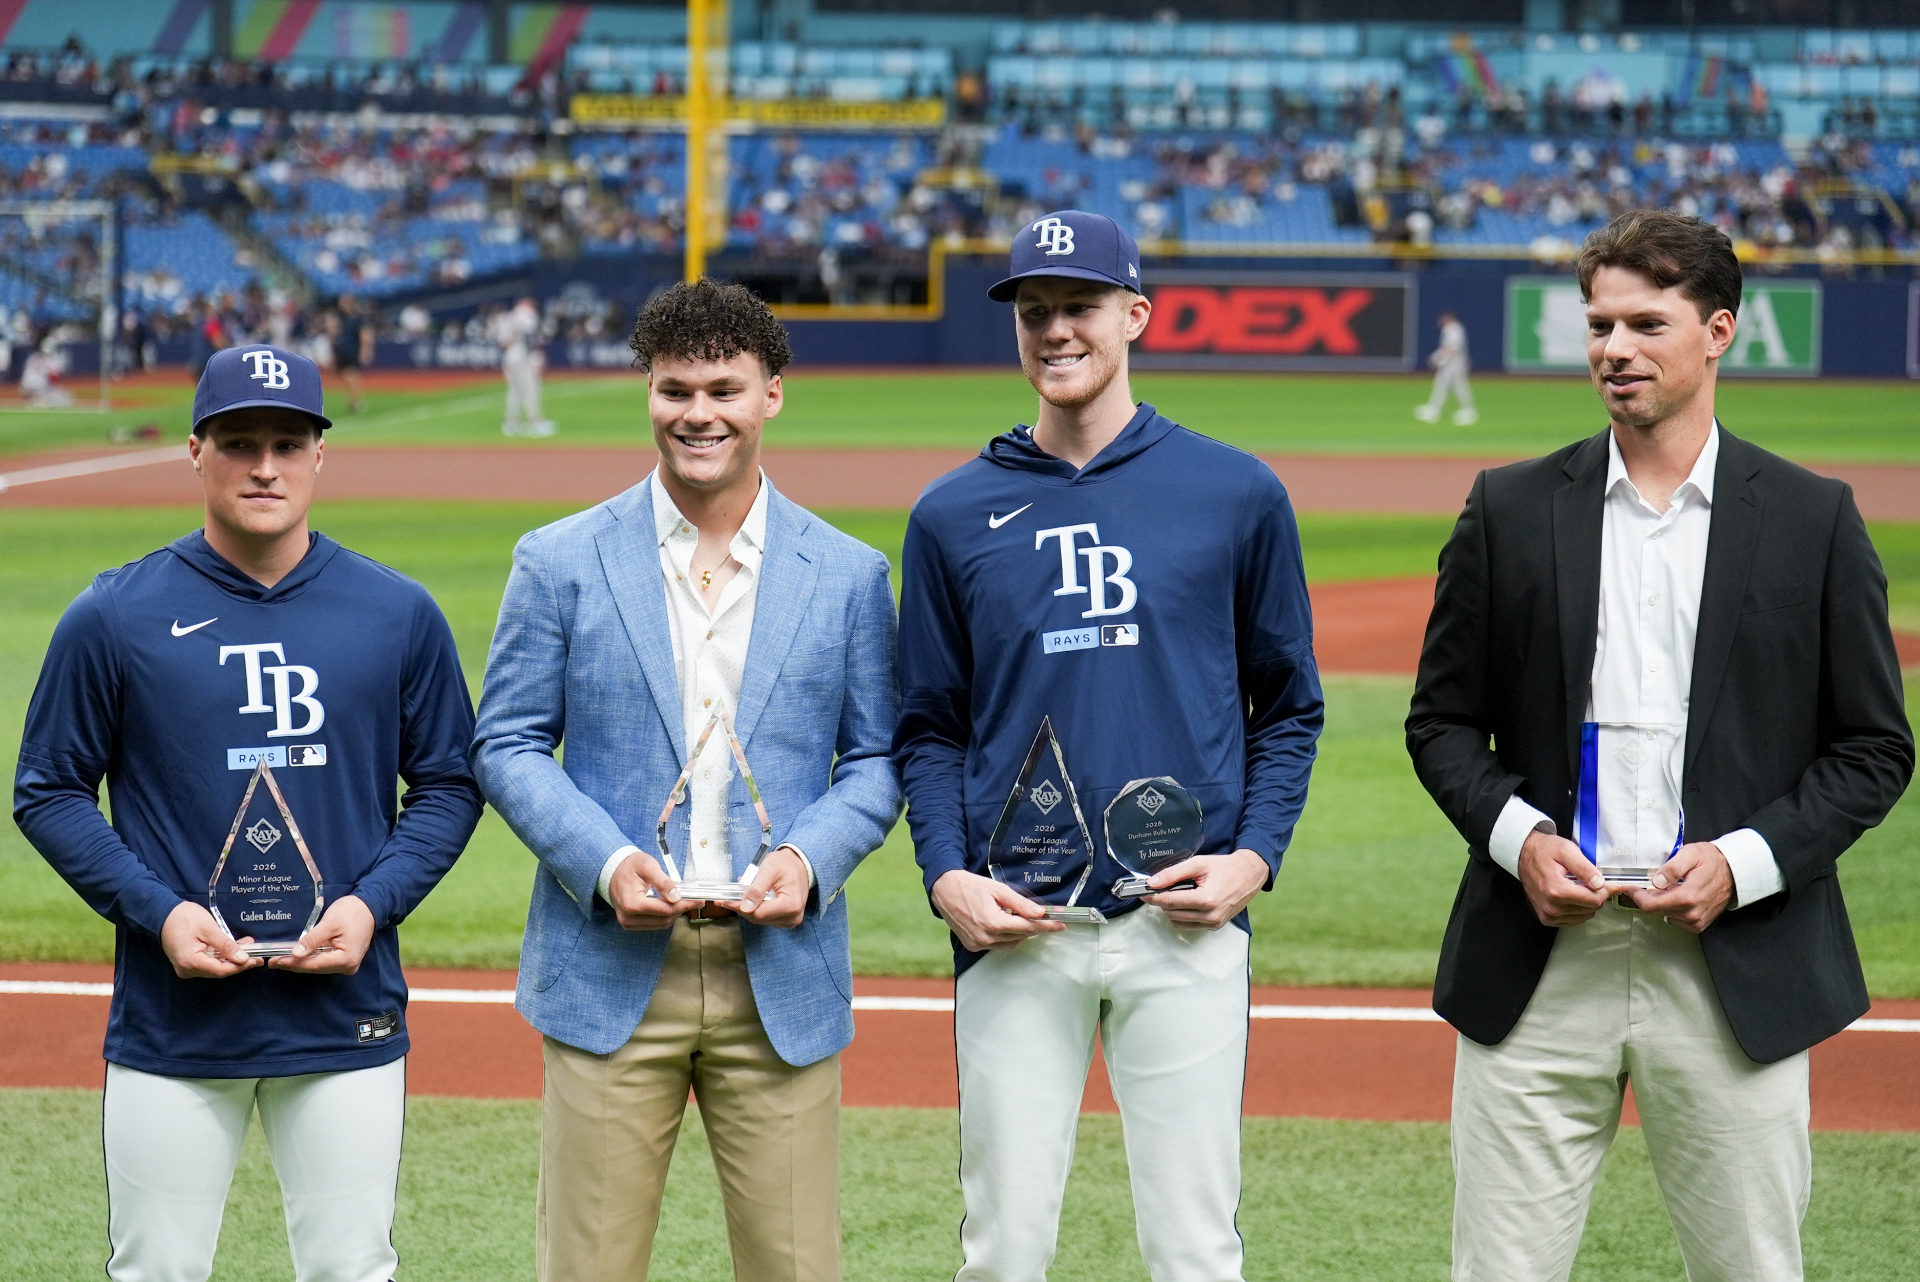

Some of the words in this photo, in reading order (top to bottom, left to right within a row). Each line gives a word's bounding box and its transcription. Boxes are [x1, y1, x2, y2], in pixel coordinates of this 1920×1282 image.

[1031, 217, 1075, 256] TB
[1142, 285, 1373, 355] DEX
[241, 350, 291, 390] TB
[1035, 522, 1139, 619] TB
[1053, 633, 1091, 647] RAYS
[218, 642, 326, 738] TB
[1034, 824, 1056, 832] 2026
[1145, 820, 1163, 828] 2026
[1020, 836, 1041, 844] Minor
[1042, 836, 1069, 846] League
[1128, 832, 1152, 840] Durham
[1012, 845, 1038, 854] Pitcher
[1038, 846, 1047, 855] of
[1047, 846, 1060, 854] the
[1060, 846, 1077, 855] Year
[1138, 850, 1147, 860] Ty
[1147, 848, 1174, 859] Johnson
[253, 862, 277, 871] 2026
[238, 875, 261, 883] Minor
[263, 875, 292, 884] League
[1023, 871, 1031, 884] Ty
[1032, 871, 1062, 883] Johnson
[231, 885, 255, 894] Player
[257, 884, 266, 893] of
[267, 884, 281, 892] the
[282, 884, 300, 892] Year
[240, 911, 264, 922] Caden
[265, 910, 292, 920] Bodine
